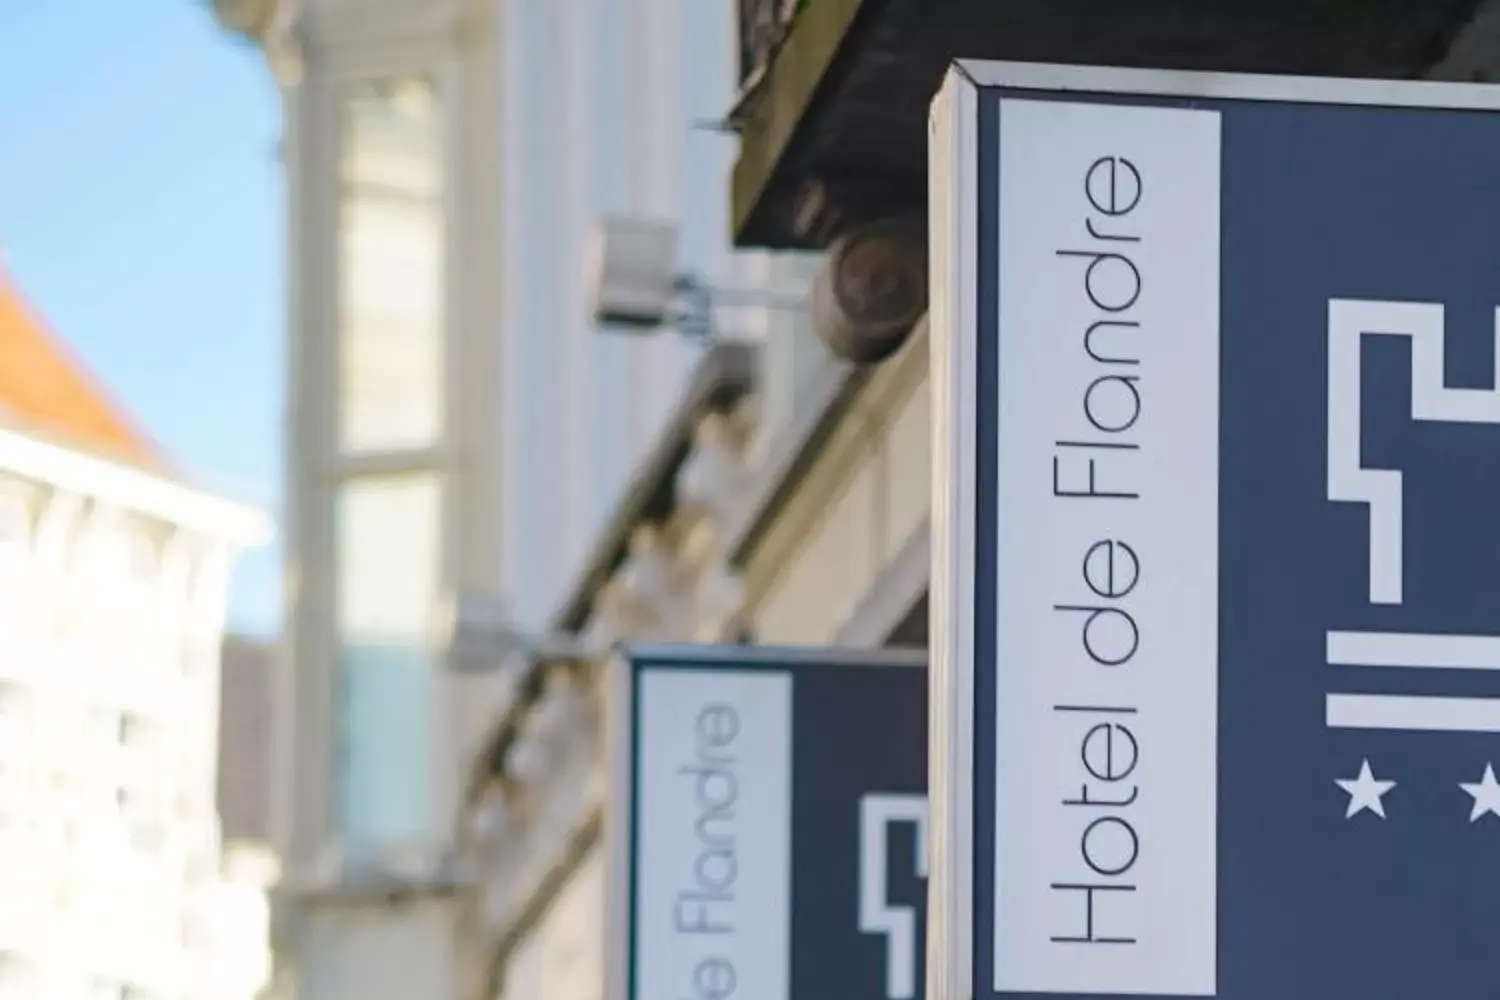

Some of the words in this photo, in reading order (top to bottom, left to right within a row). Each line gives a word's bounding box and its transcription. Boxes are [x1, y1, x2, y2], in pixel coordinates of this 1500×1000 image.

[1052, 154, 1143, 500] Flandre
[1052, 537, 1141, 668] de
[673, 703, 741, 935] Flandre
[1049, 704, 1140, 945] Hotel
